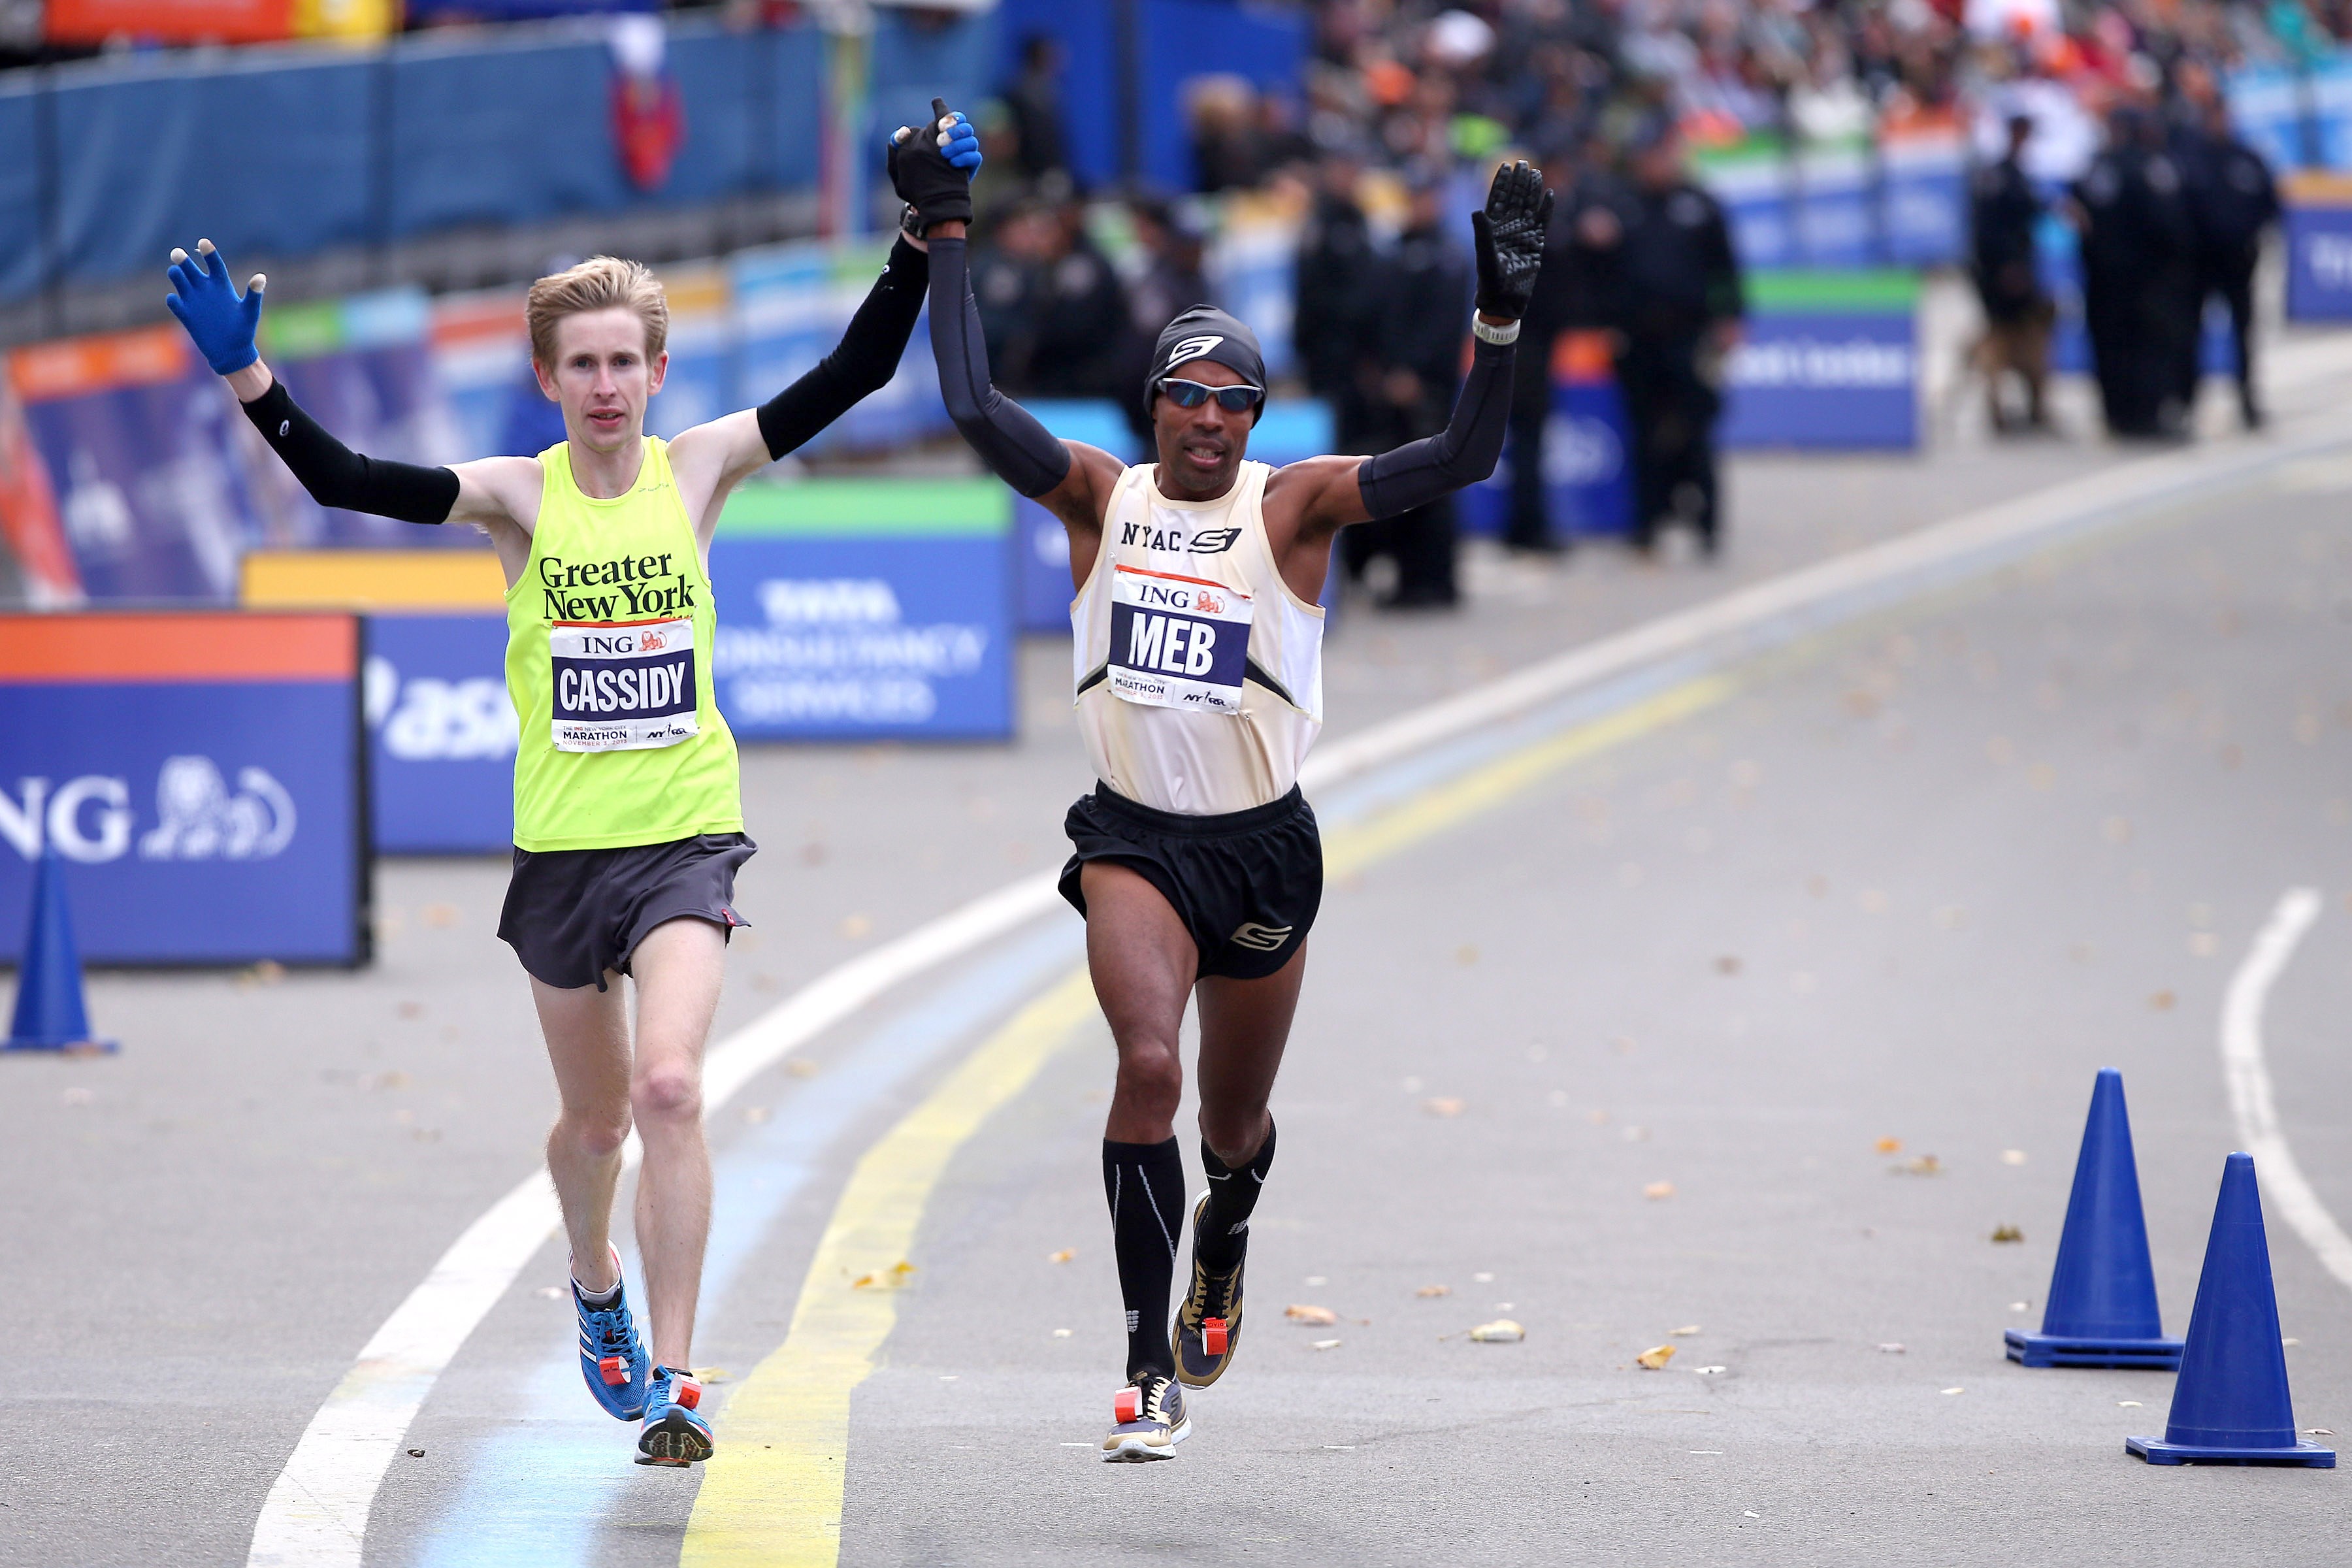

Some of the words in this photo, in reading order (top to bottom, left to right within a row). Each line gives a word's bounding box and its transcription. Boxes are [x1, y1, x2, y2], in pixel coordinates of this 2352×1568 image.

[1121, 522, 1182, 551] NYAC
[540, 553, 672, 588] Greater
[543, 589, 619, 620] New
[617, 574, 694, 615] York
[1139, 584, 1190, 608] ING
[582, 636, 634, 653] ING
[1128, 612, 1217, 676] MEB
[559, 662, 685, 712] CASSIDY
[563, 730, 627, 740] MARATHON
